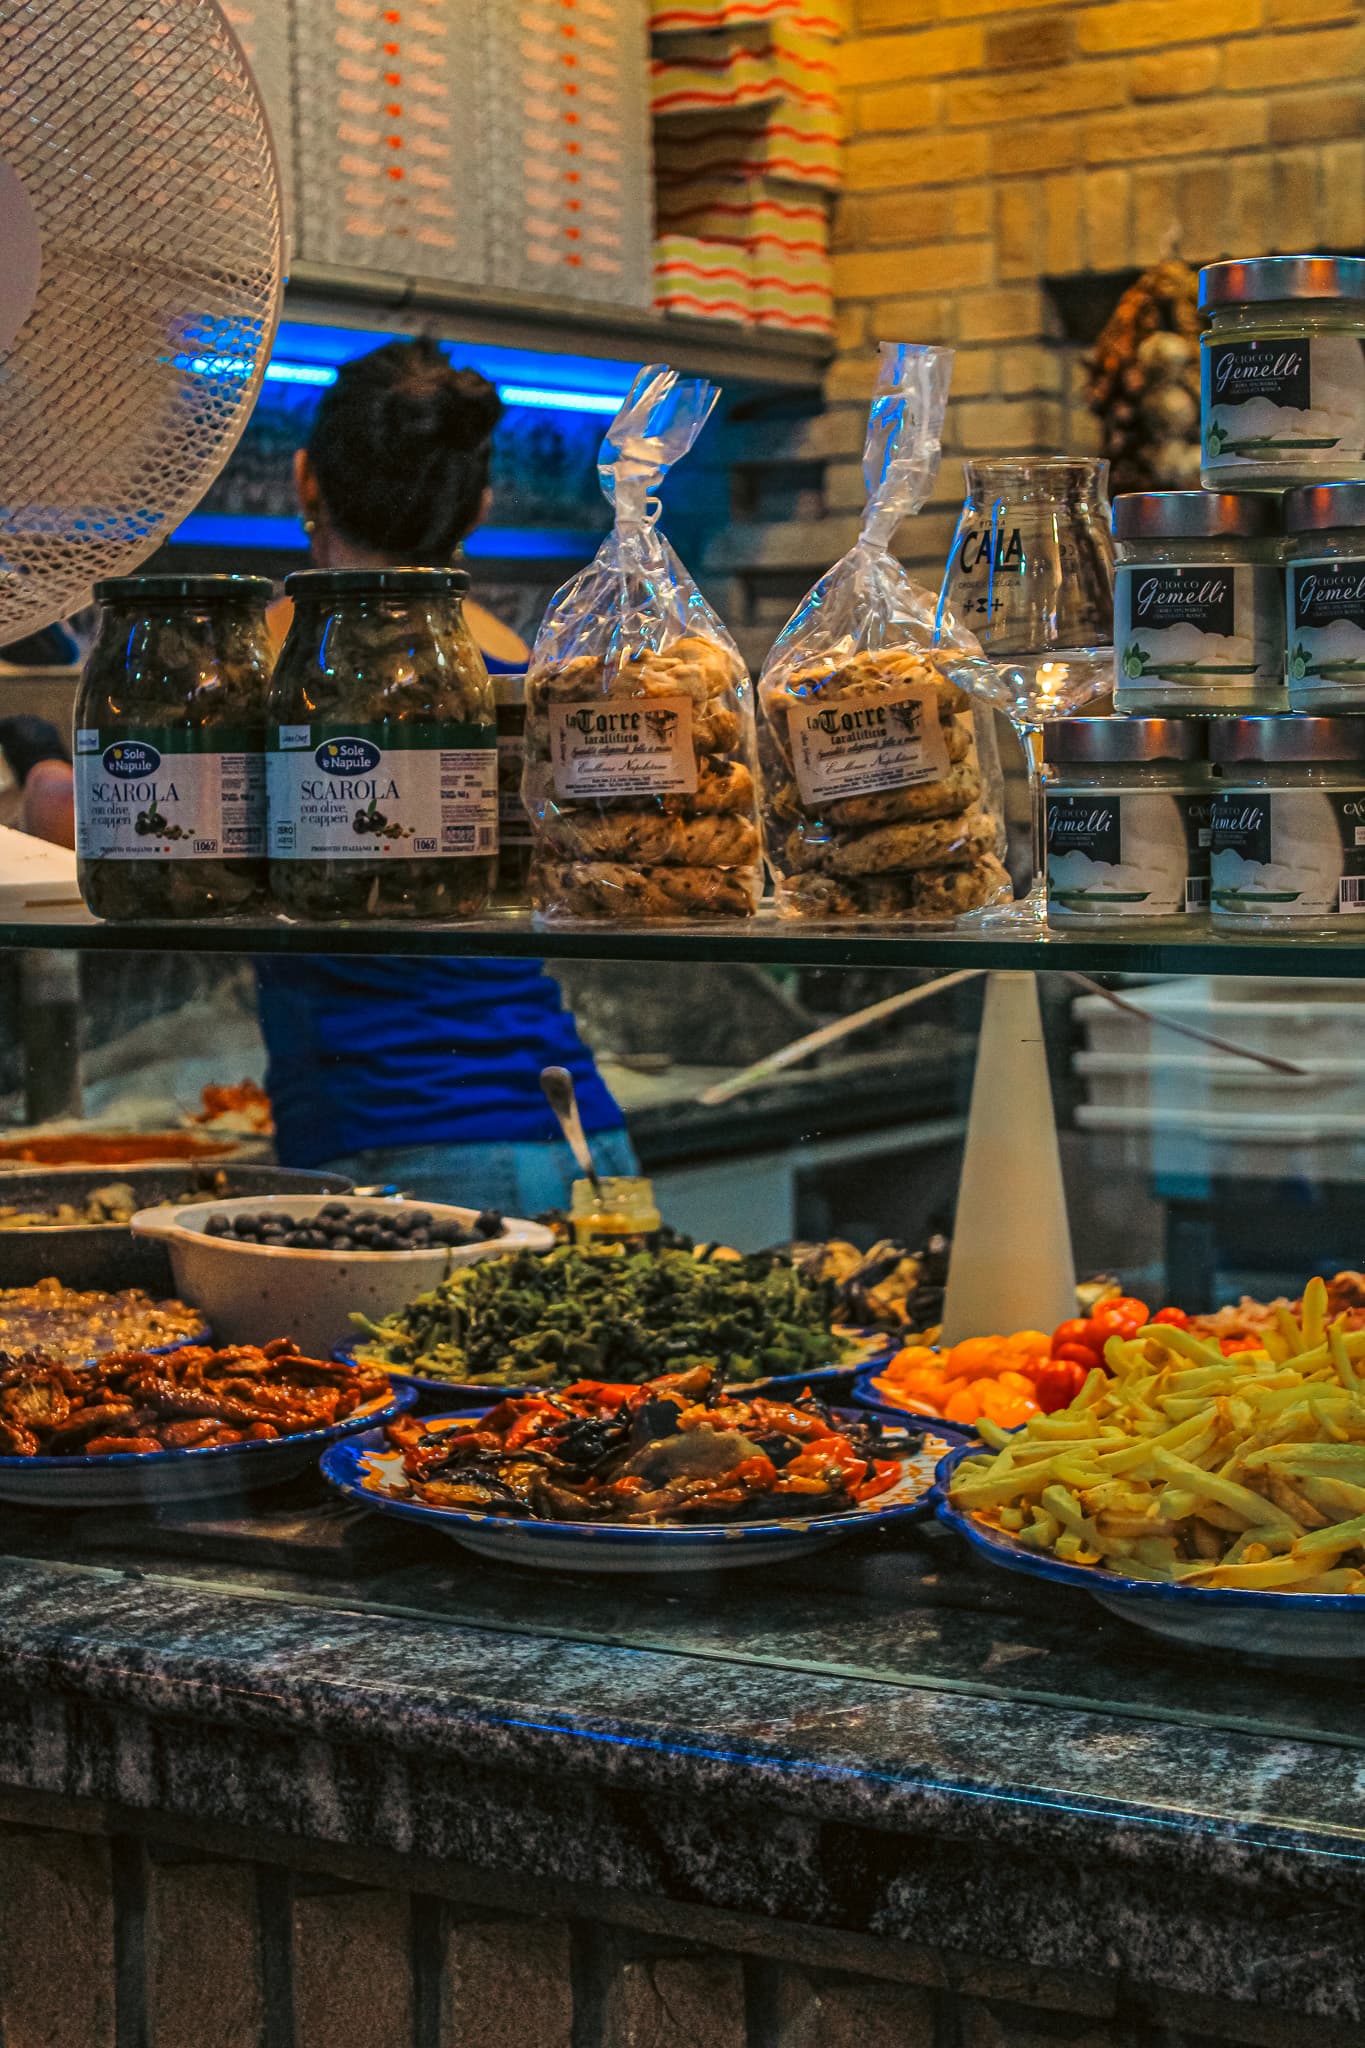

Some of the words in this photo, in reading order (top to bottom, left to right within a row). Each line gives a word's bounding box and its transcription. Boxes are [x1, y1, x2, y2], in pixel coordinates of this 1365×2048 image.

[1216, 352, 1302, 392] Gemelli
[960, 528, 1024, 574] CALA
[1137, 577, 1228, 616] Gemelli
[576, 708, 641, 734] Torre
[817, 705, 888, 735] Torre
[123, 750, 146, 760] Sole
[340, 745, 365, 756] Sole
[115, 760, 152, 773] Napule
[331, 758, 372, 770] Napule
[91, 782, 180, 802] SCAROLA
[300, 780, 400, 801] SCAROLA
[300, 804, 318, 814] con
[308, 815, 349, 827] capperi
[195, 840, 217, 851] 1062
[416, 840, 436, 850] 1062
